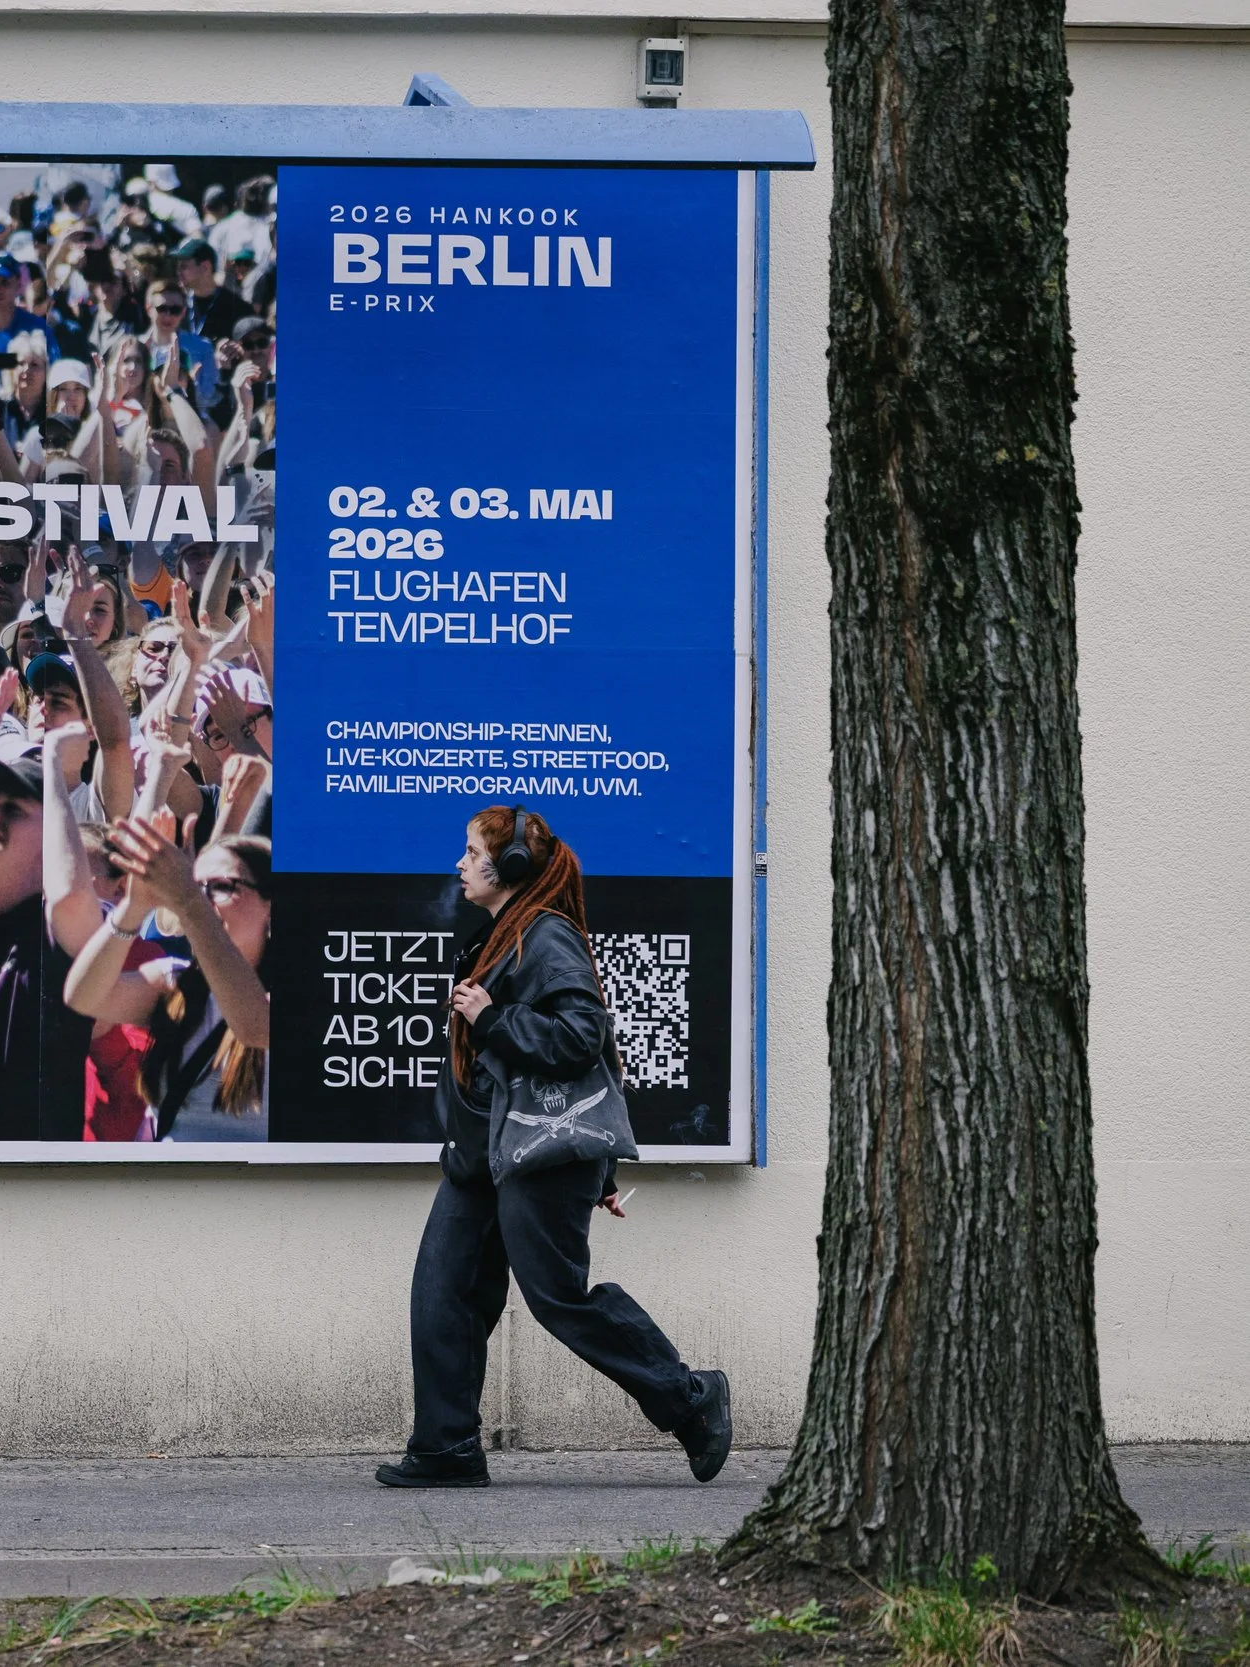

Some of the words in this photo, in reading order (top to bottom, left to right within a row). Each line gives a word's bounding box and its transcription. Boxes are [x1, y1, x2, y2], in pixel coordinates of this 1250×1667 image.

[330, 205, 412, 224] 2026
[430, 207, 579, 226] HANKOOK
[333, 233, 612, 287] BERLIN
[329, 294, 435, 312] E-PRIX
[328, 486, 398, 518] 02.
[406, 487, 441, 519] &
[450, 488, 519, 520] 03.
[529, 489, 613, 520] MAI
[328, 528, 444, 560] 2026
[329, 570, 566, 602] FLUGHAFEN
[328, 612, 573, 645] TEMPELHOF
[326, 721, 612, 744] CHAMPIONSHIP-RENNEN,
[326, 748, 508, 770] LIVE-KONZERTE,
[512, 750, 670, 772] STREETFOOD,
[326, 775, 579, 798] FAMILIENPROGRAMM,
[582, 778, 642, 797] UVM.
[323, 931, 454, 963] JETZT
[322, 1015, 380, 1046] AB
[387, 1015, 434, 1047] 10
[323, 1056, 446, 1088] SICHE
